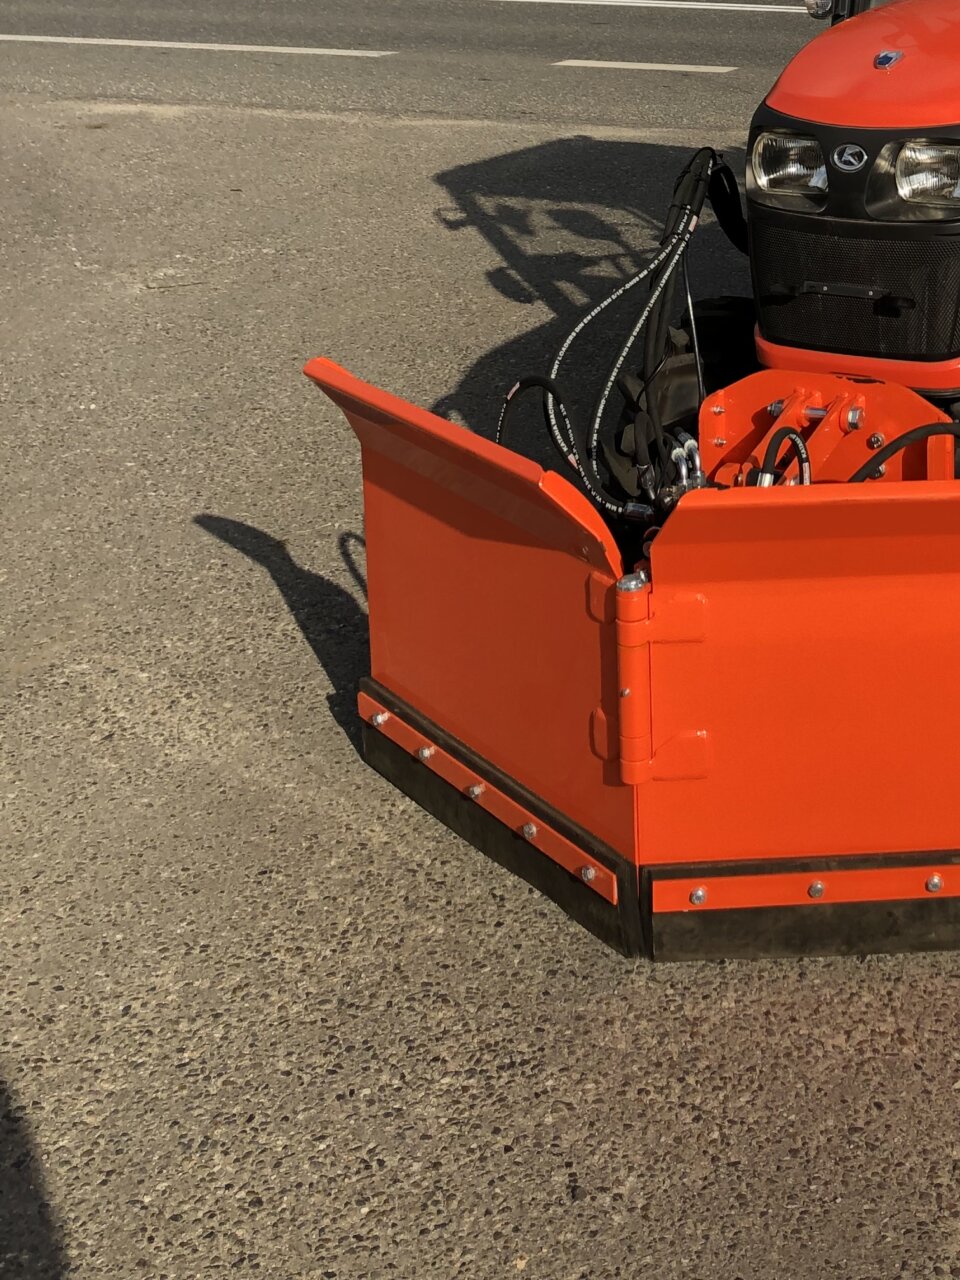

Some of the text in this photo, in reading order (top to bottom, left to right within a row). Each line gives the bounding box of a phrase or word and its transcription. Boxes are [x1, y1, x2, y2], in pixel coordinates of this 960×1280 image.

[557, 332, 577, 361] LOADERS
[550, 360, 560, 379] RONT
[547, 392, 557, 426] MACHIN
